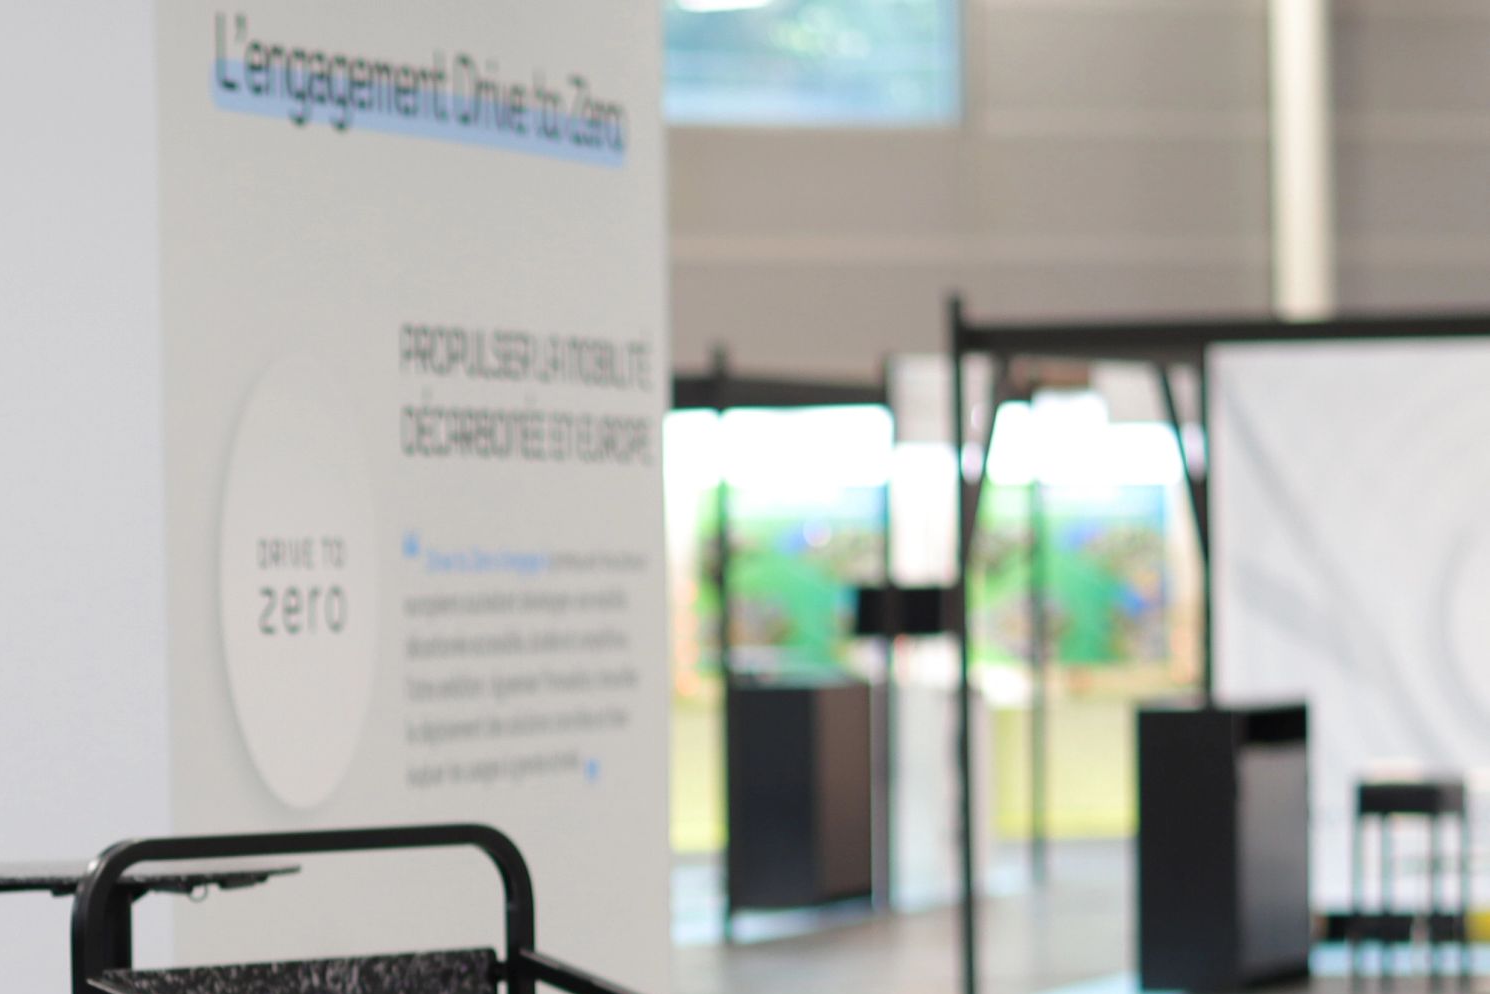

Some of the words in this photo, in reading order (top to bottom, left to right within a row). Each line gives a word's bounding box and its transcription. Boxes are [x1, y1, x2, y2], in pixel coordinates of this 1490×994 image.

[256, 535, 314, 570] DRIVE
[320, 535, 348, 569] TO
[257, 585, 349, 635] zero
